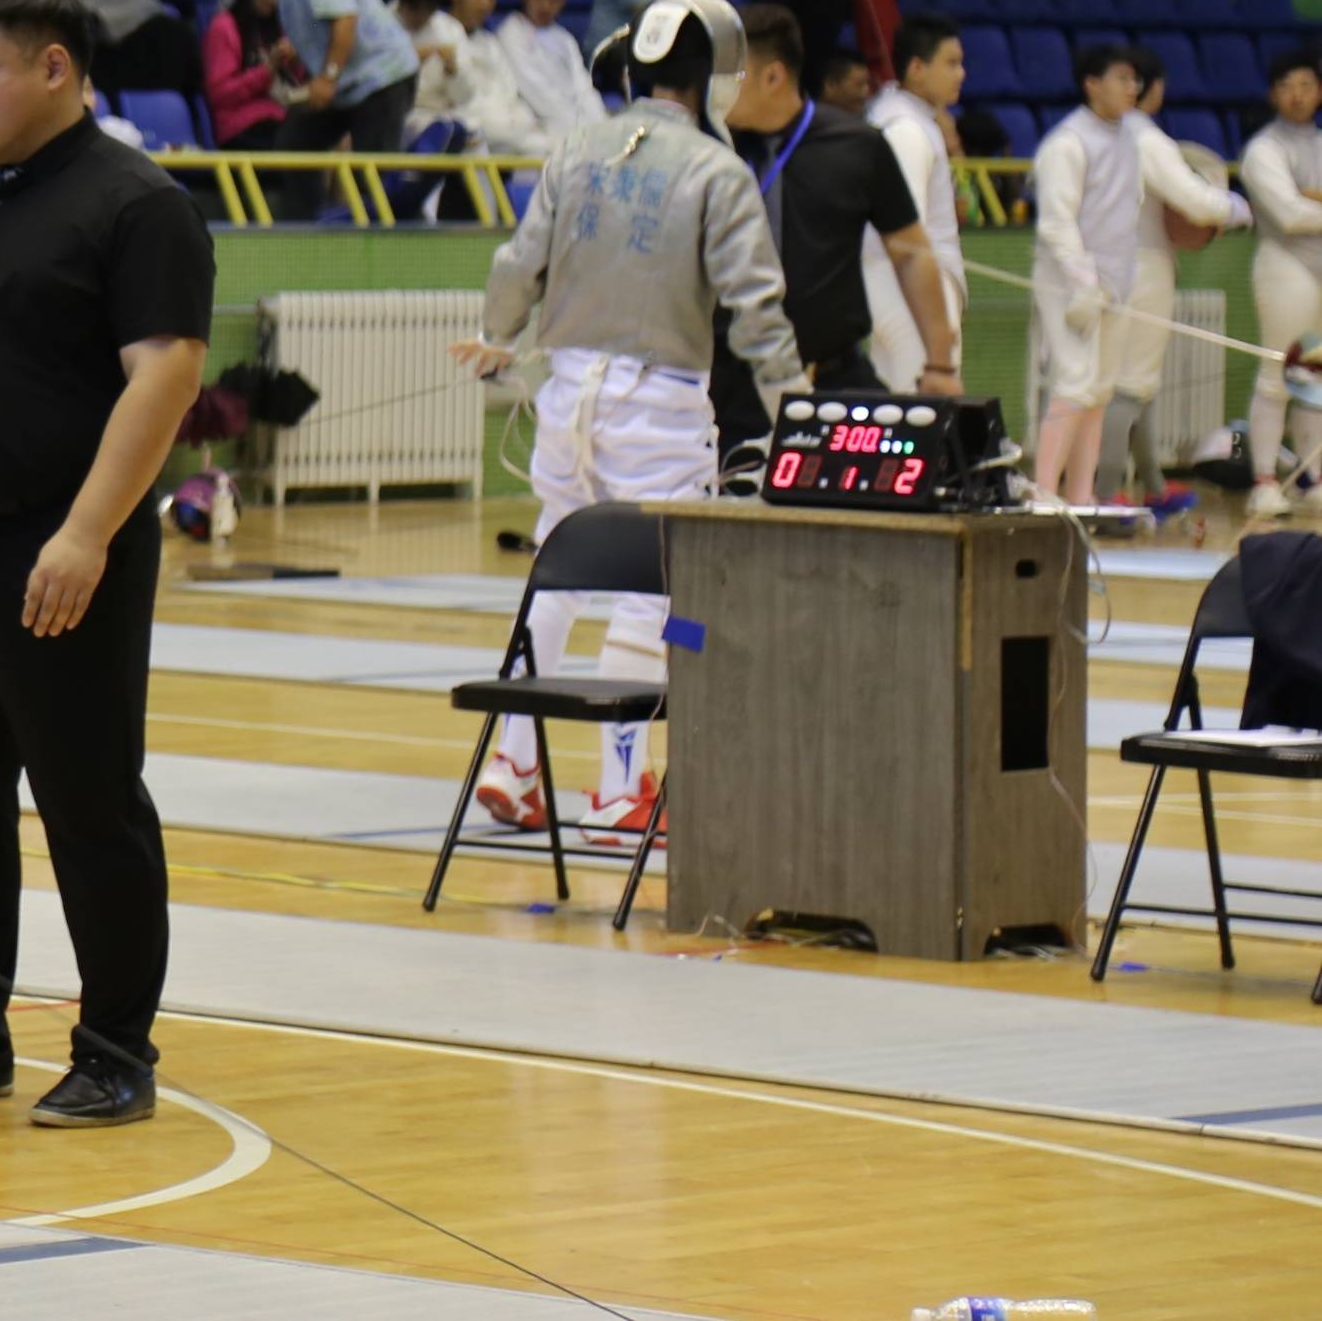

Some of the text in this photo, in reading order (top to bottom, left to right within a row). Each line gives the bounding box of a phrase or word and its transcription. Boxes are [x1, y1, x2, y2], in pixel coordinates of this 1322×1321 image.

[772, 452, 925, 495] 0 1 2
